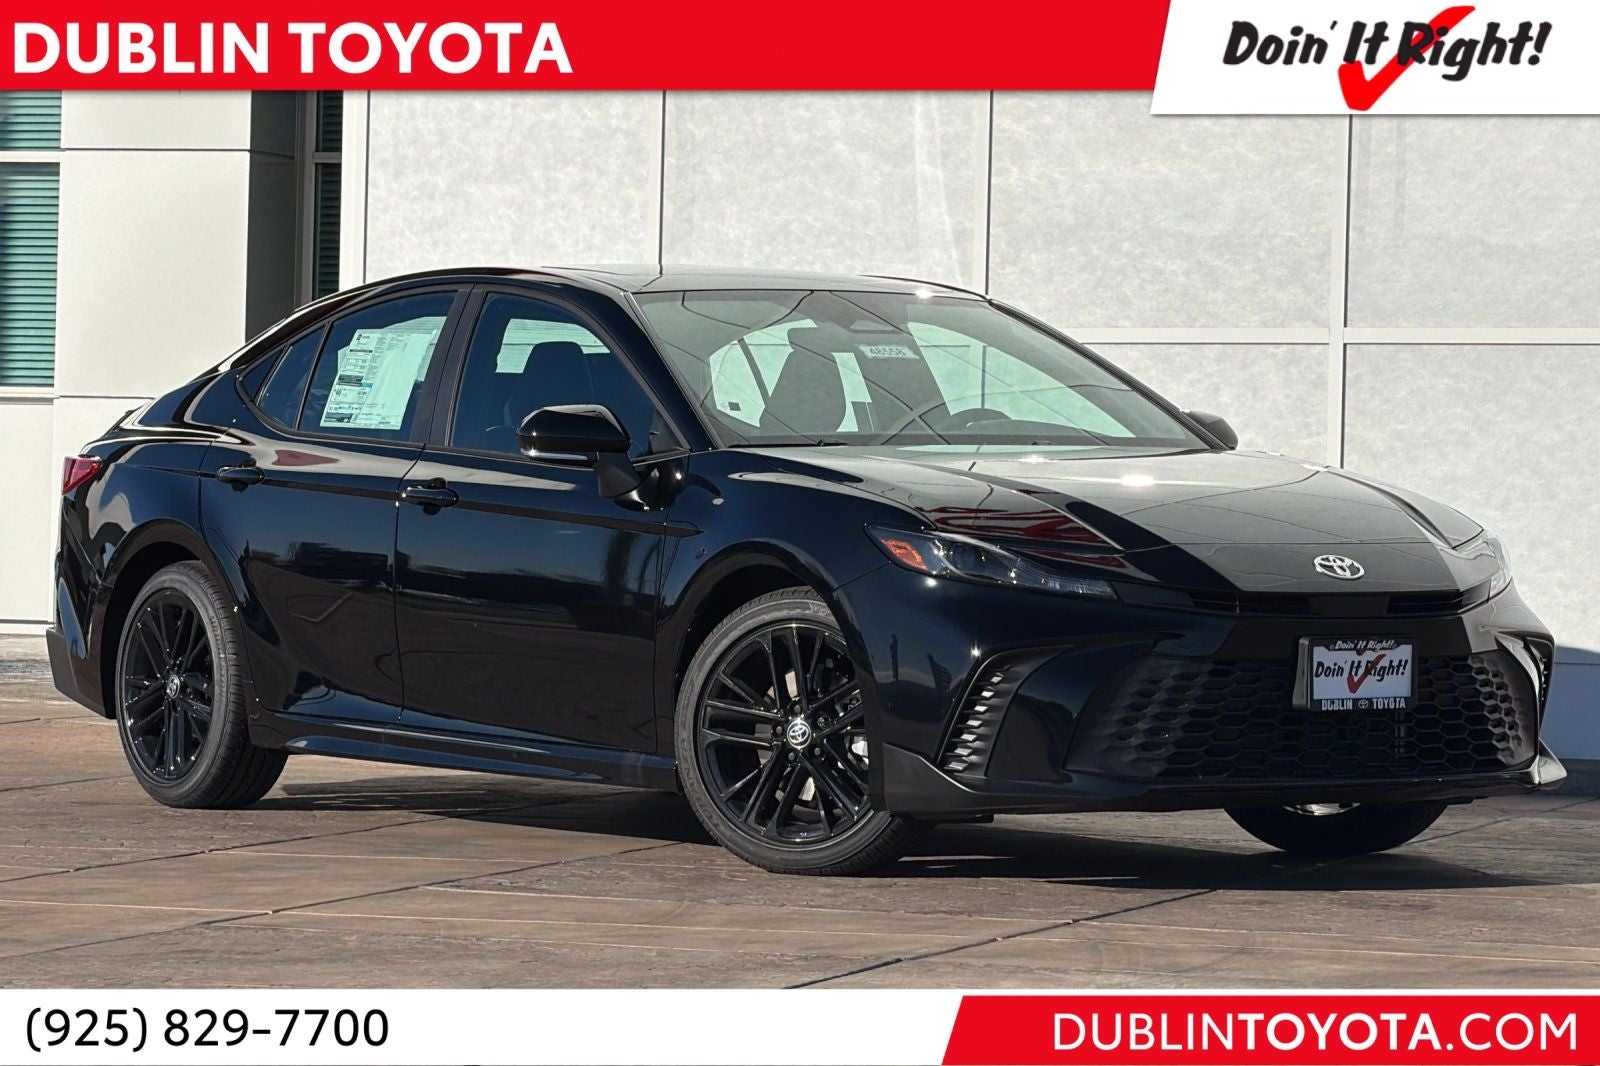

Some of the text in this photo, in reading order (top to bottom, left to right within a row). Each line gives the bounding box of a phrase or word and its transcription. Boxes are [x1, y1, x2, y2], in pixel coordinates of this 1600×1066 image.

[1314, 659, 1348, 678] Doin'
[1348, 660, 1363, 677] It
[1321, 698, 1406, 711] DUBLIN TOYOTA
